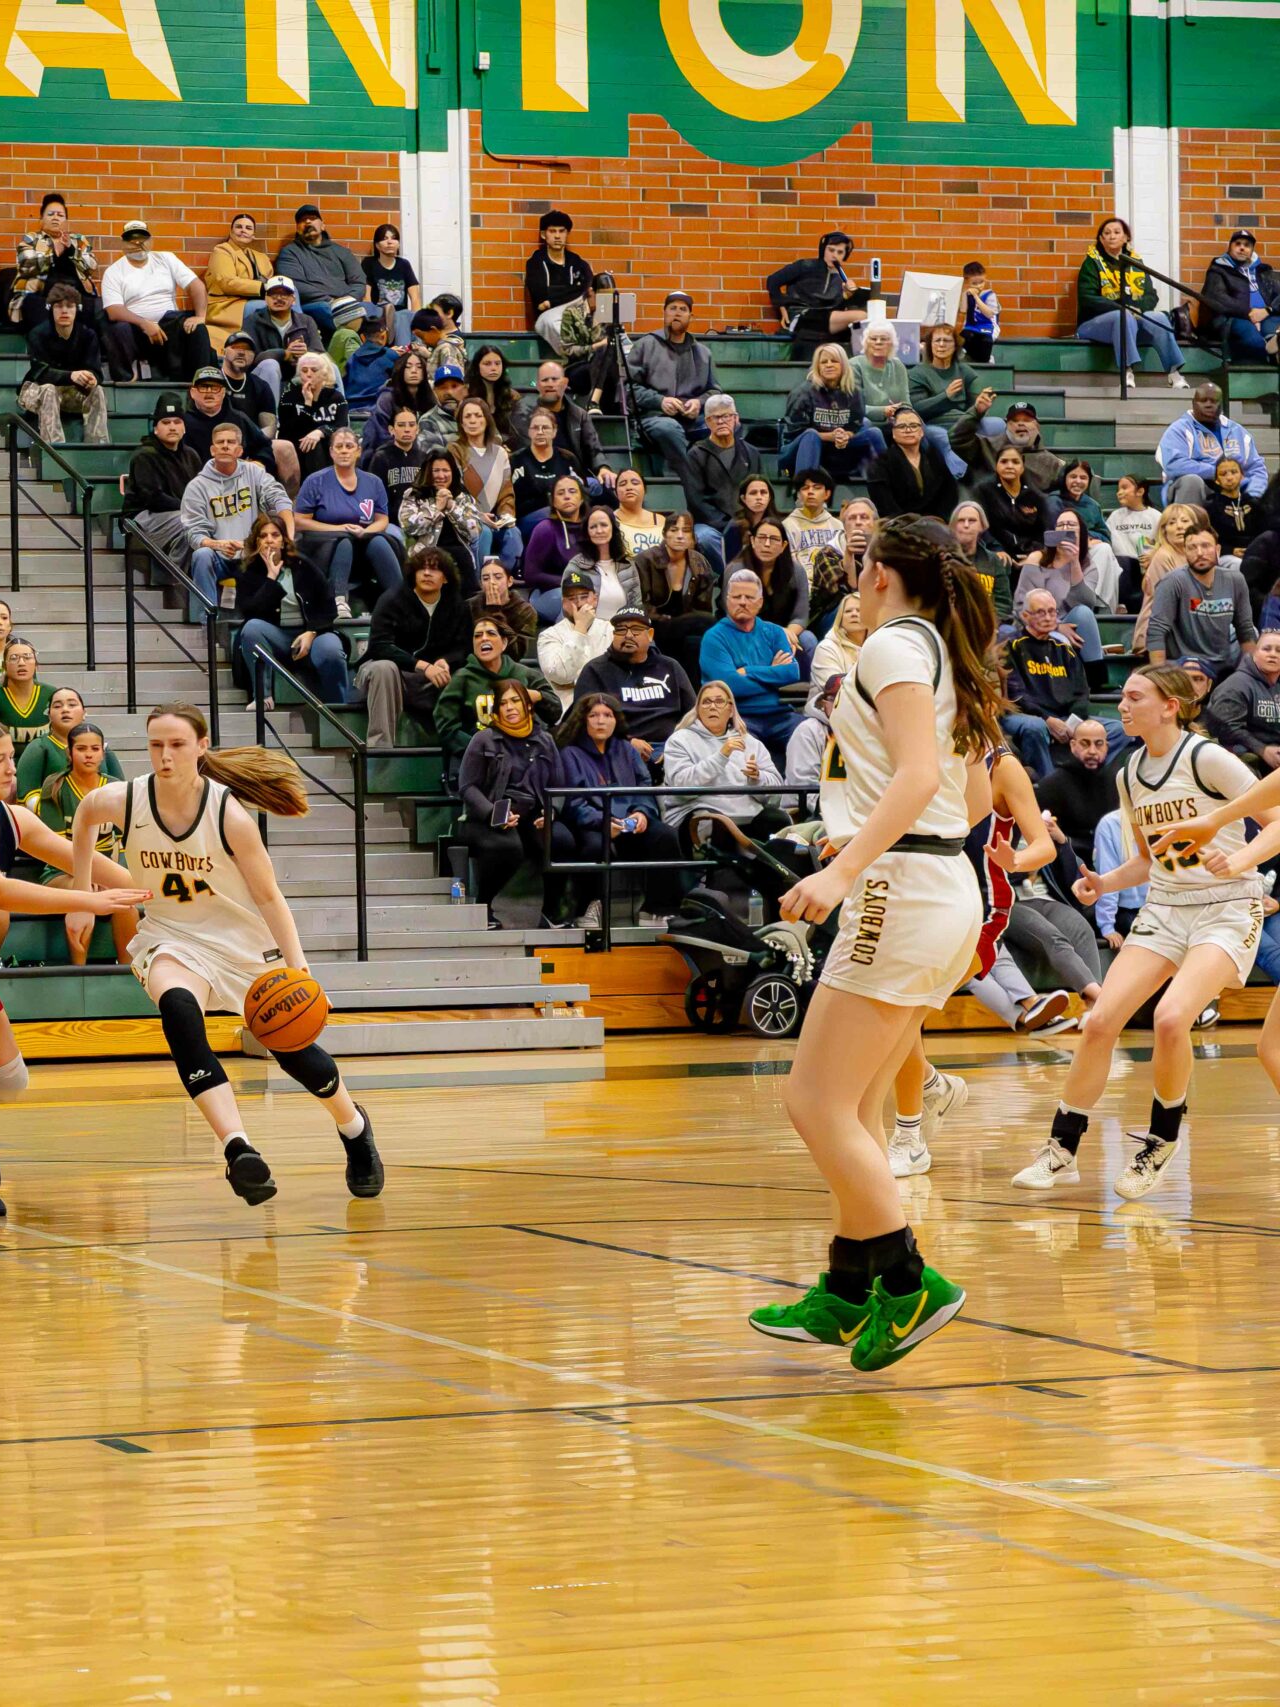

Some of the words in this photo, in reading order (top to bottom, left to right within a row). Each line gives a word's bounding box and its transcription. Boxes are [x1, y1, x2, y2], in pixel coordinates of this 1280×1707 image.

[208, 486, 252, 519] CHS
[622, 686, 664, 702] PUMA
[850, 879, 889, 966] COWBOYS
[259, 986, 311, 1024] Wilson
